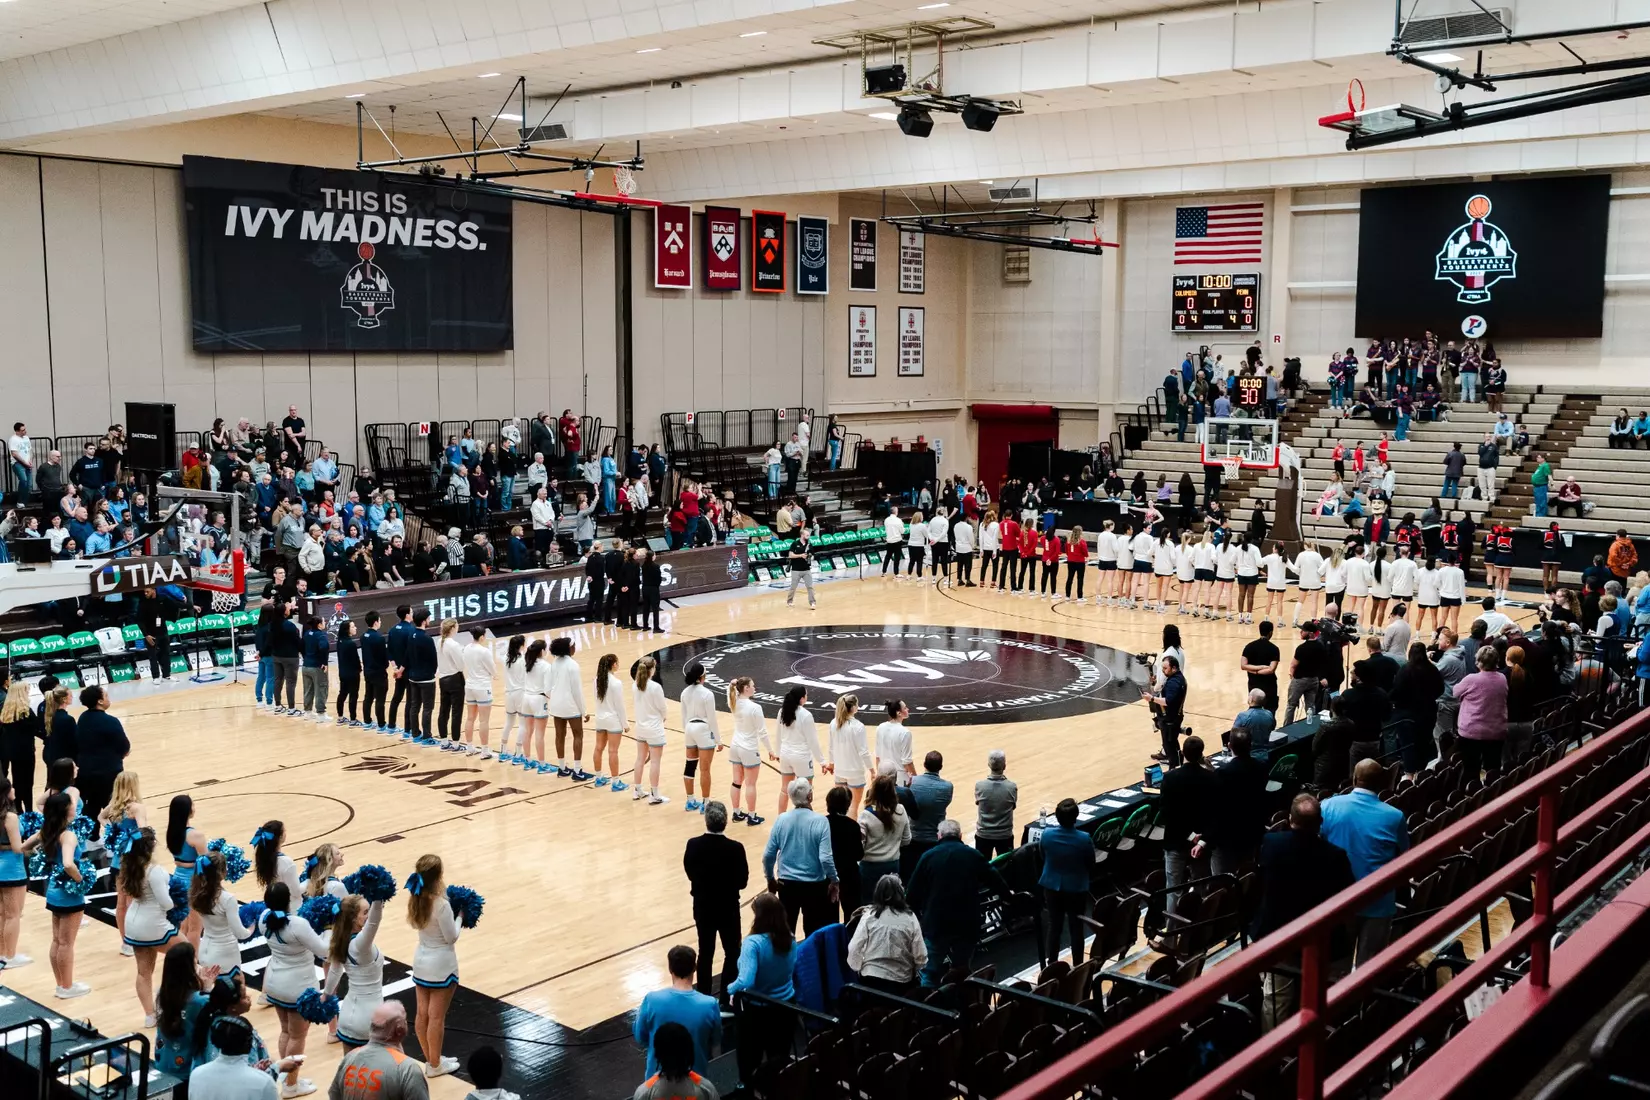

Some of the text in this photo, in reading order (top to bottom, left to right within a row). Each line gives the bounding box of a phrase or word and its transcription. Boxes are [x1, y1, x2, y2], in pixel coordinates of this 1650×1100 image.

[320, 187, 408, 214] THIS IS
[225, 204, 488, 251] IVY MADNESS.
[663, 268, 685, 278] Harvard
[759, 271, 781, 281] Princeton
[808, 274, 818, 284] Yale
[1203, 275, 1231, 288] 10:00
[1187, 297, 1195, 310] 0
[1213, 298, 1217, 308] 1
[1244, 296, 1253, 309] 0
[1179, 314, 1185, 325] 0
[1191, 315, 1197, 324] 4
[1229, 314, 1237, 324] 4
[1245, 314, 1252, 324] 0
[1273, 335, 1281, 344] R
[1240, 378, 1262, 389] 10:00
[1241, 388, 1258, 405] 30
[687, 413, 693, 422] P
[779, 409, 785, 418] Q
[421, 423, 429, 434] N
[124, 559, 188, 588] TIAA
[423, 593, 481, 622] THIS
[487, 590, 510, 613] IS
[514, 581, 554, 609] IVY
[817, 632, 941, 640] COLUMBIA
[722, 637, 797, 654] BROWN
[967, 637, 1058, 655] CORNELL
[1064, 656, 1100, 692] DARTMOUTH
[938, 691, 1062, 711] HARVARD
[344, 1064, 384, 1092] ESS
